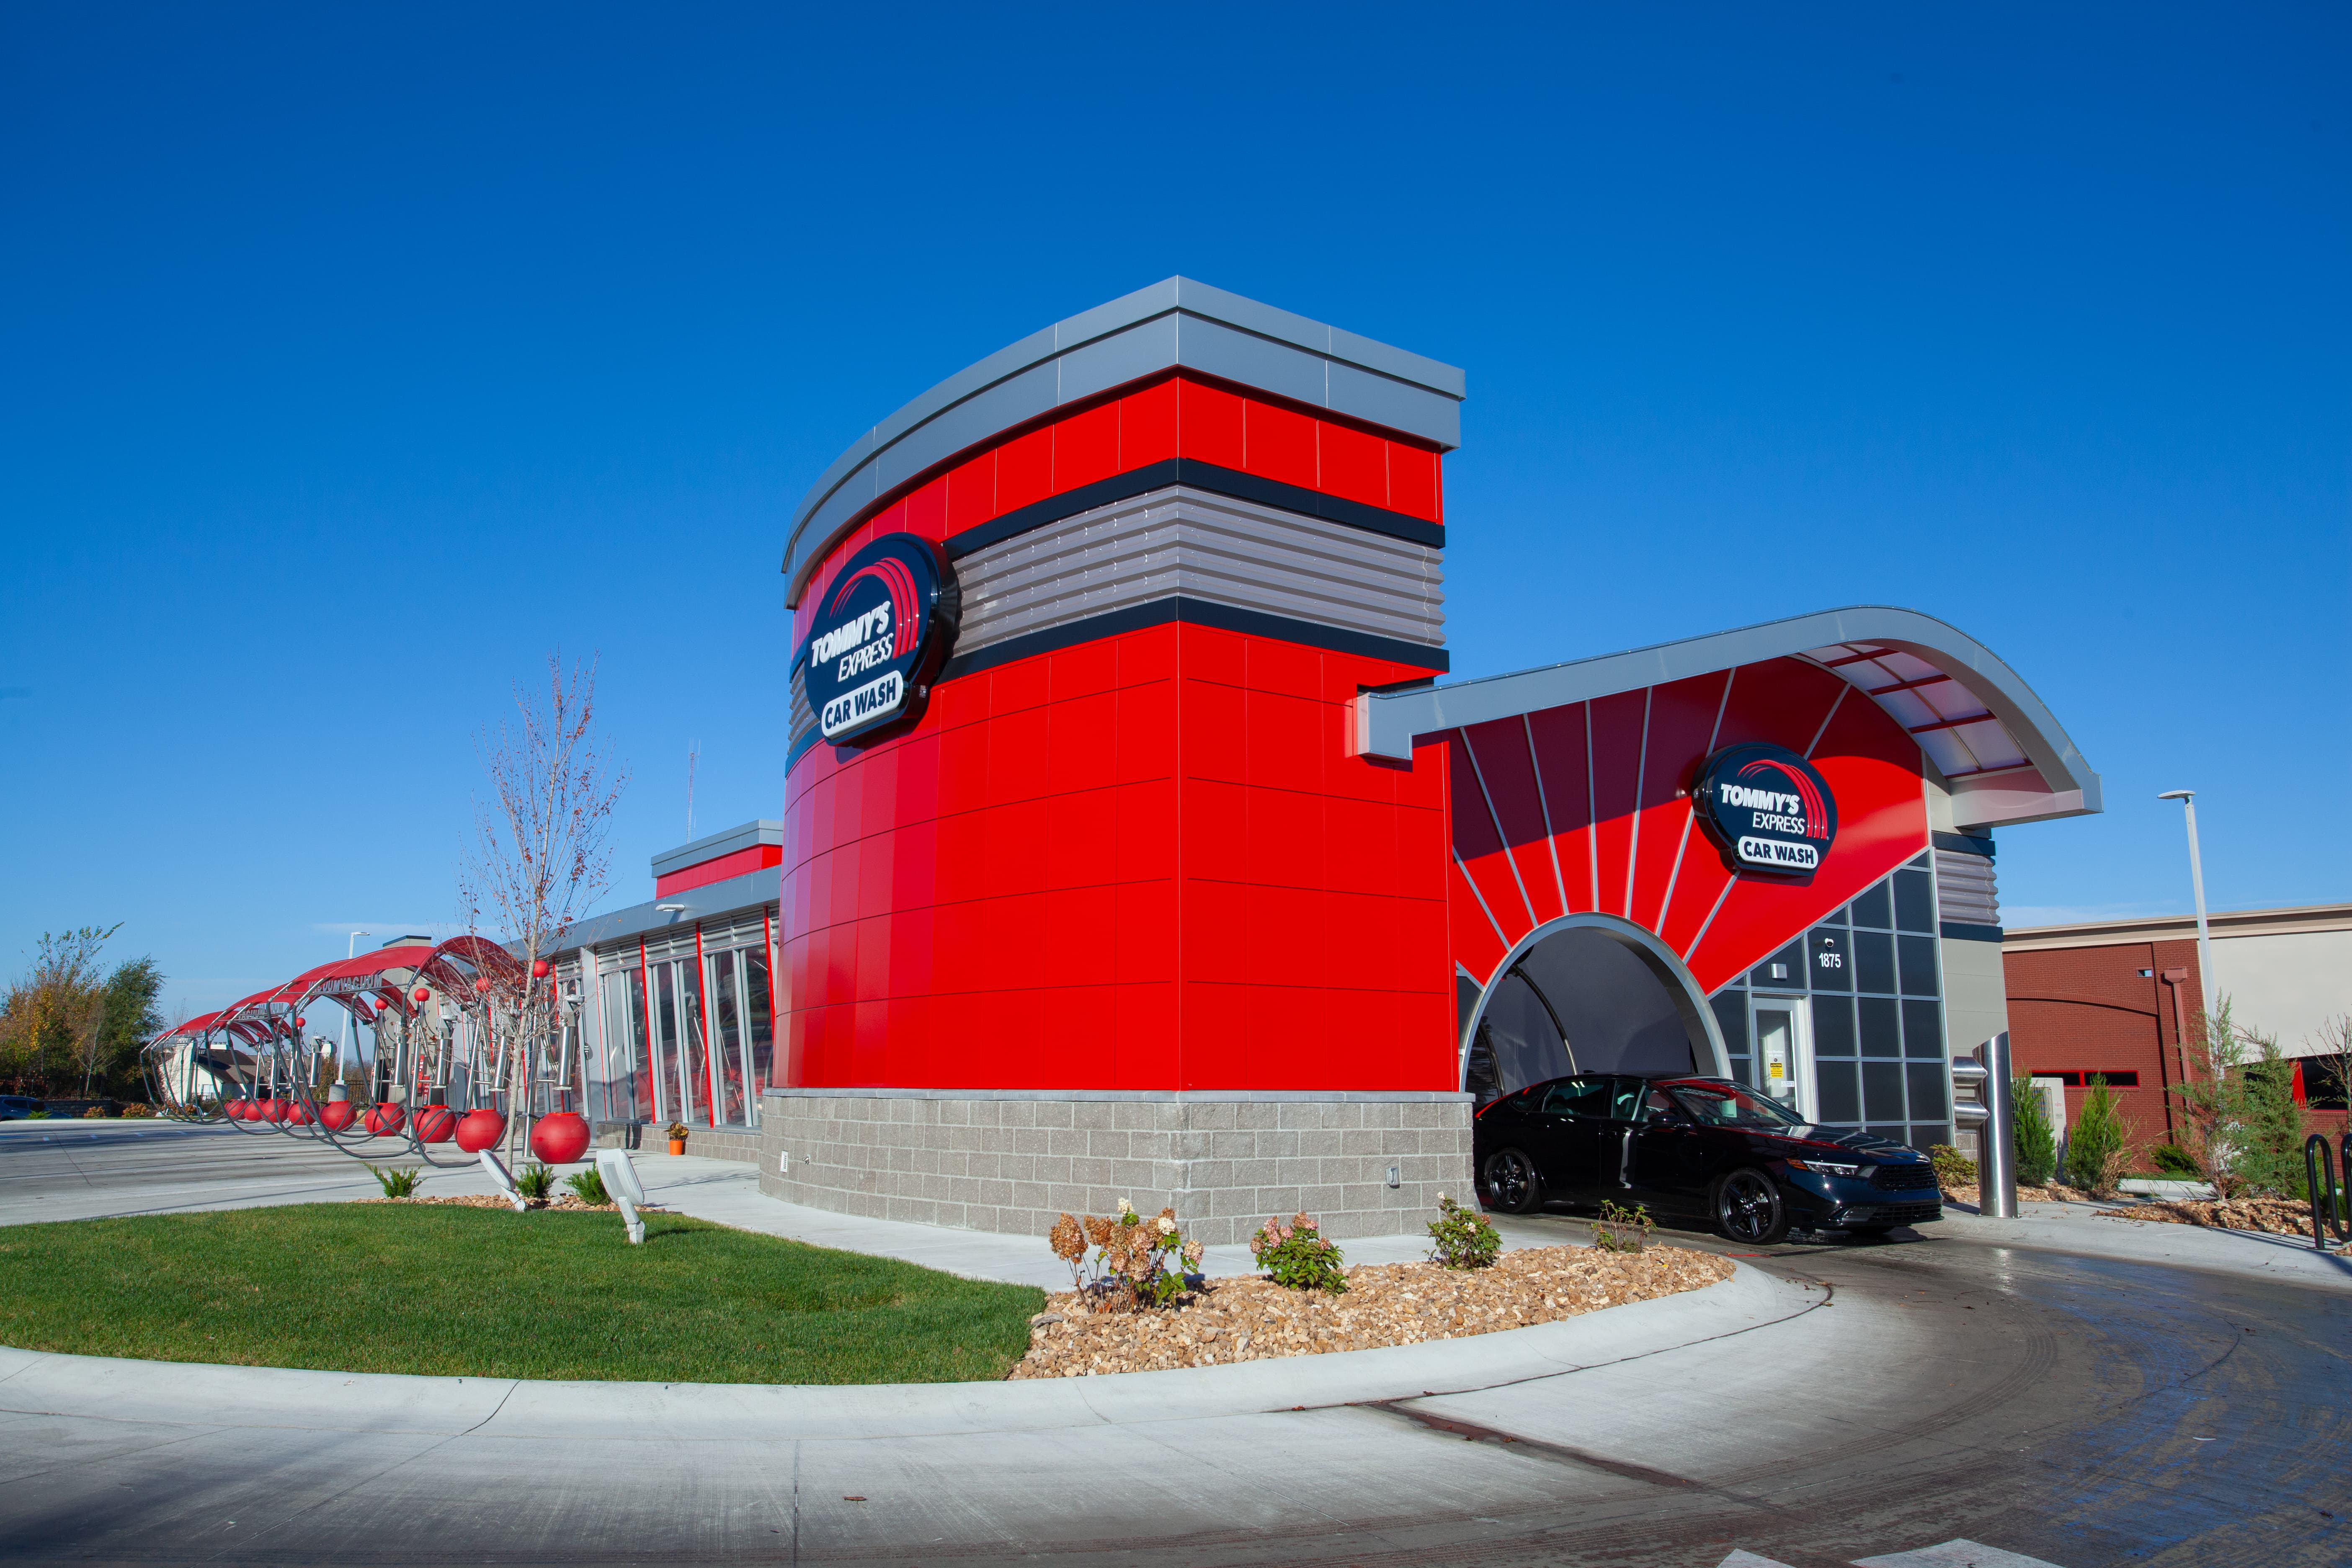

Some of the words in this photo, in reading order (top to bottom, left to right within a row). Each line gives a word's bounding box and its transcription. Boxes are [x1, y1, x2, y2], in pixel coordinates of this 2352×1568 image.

[811, 601, 891, 668] TOMMY'S
[838, 632, 894, 683] EXPRESS
[825, 703, 851, 730] CAR
[855, 677, 896, 717] WASH
[1720, 783, 1800, 815] TOMMY'S
[1752, 812, 1805, 835] EXPRESS
[1744, 841, 1772, 859] CAR
[1774, 845, 1814, 864] WASH
[1819, 952, 1841, 968] 1875
[308, 980, 340, 993] VUUM
[340, 974, 382, 992] VACUUM
[258, 1003, 284, 1015] VAUUM
